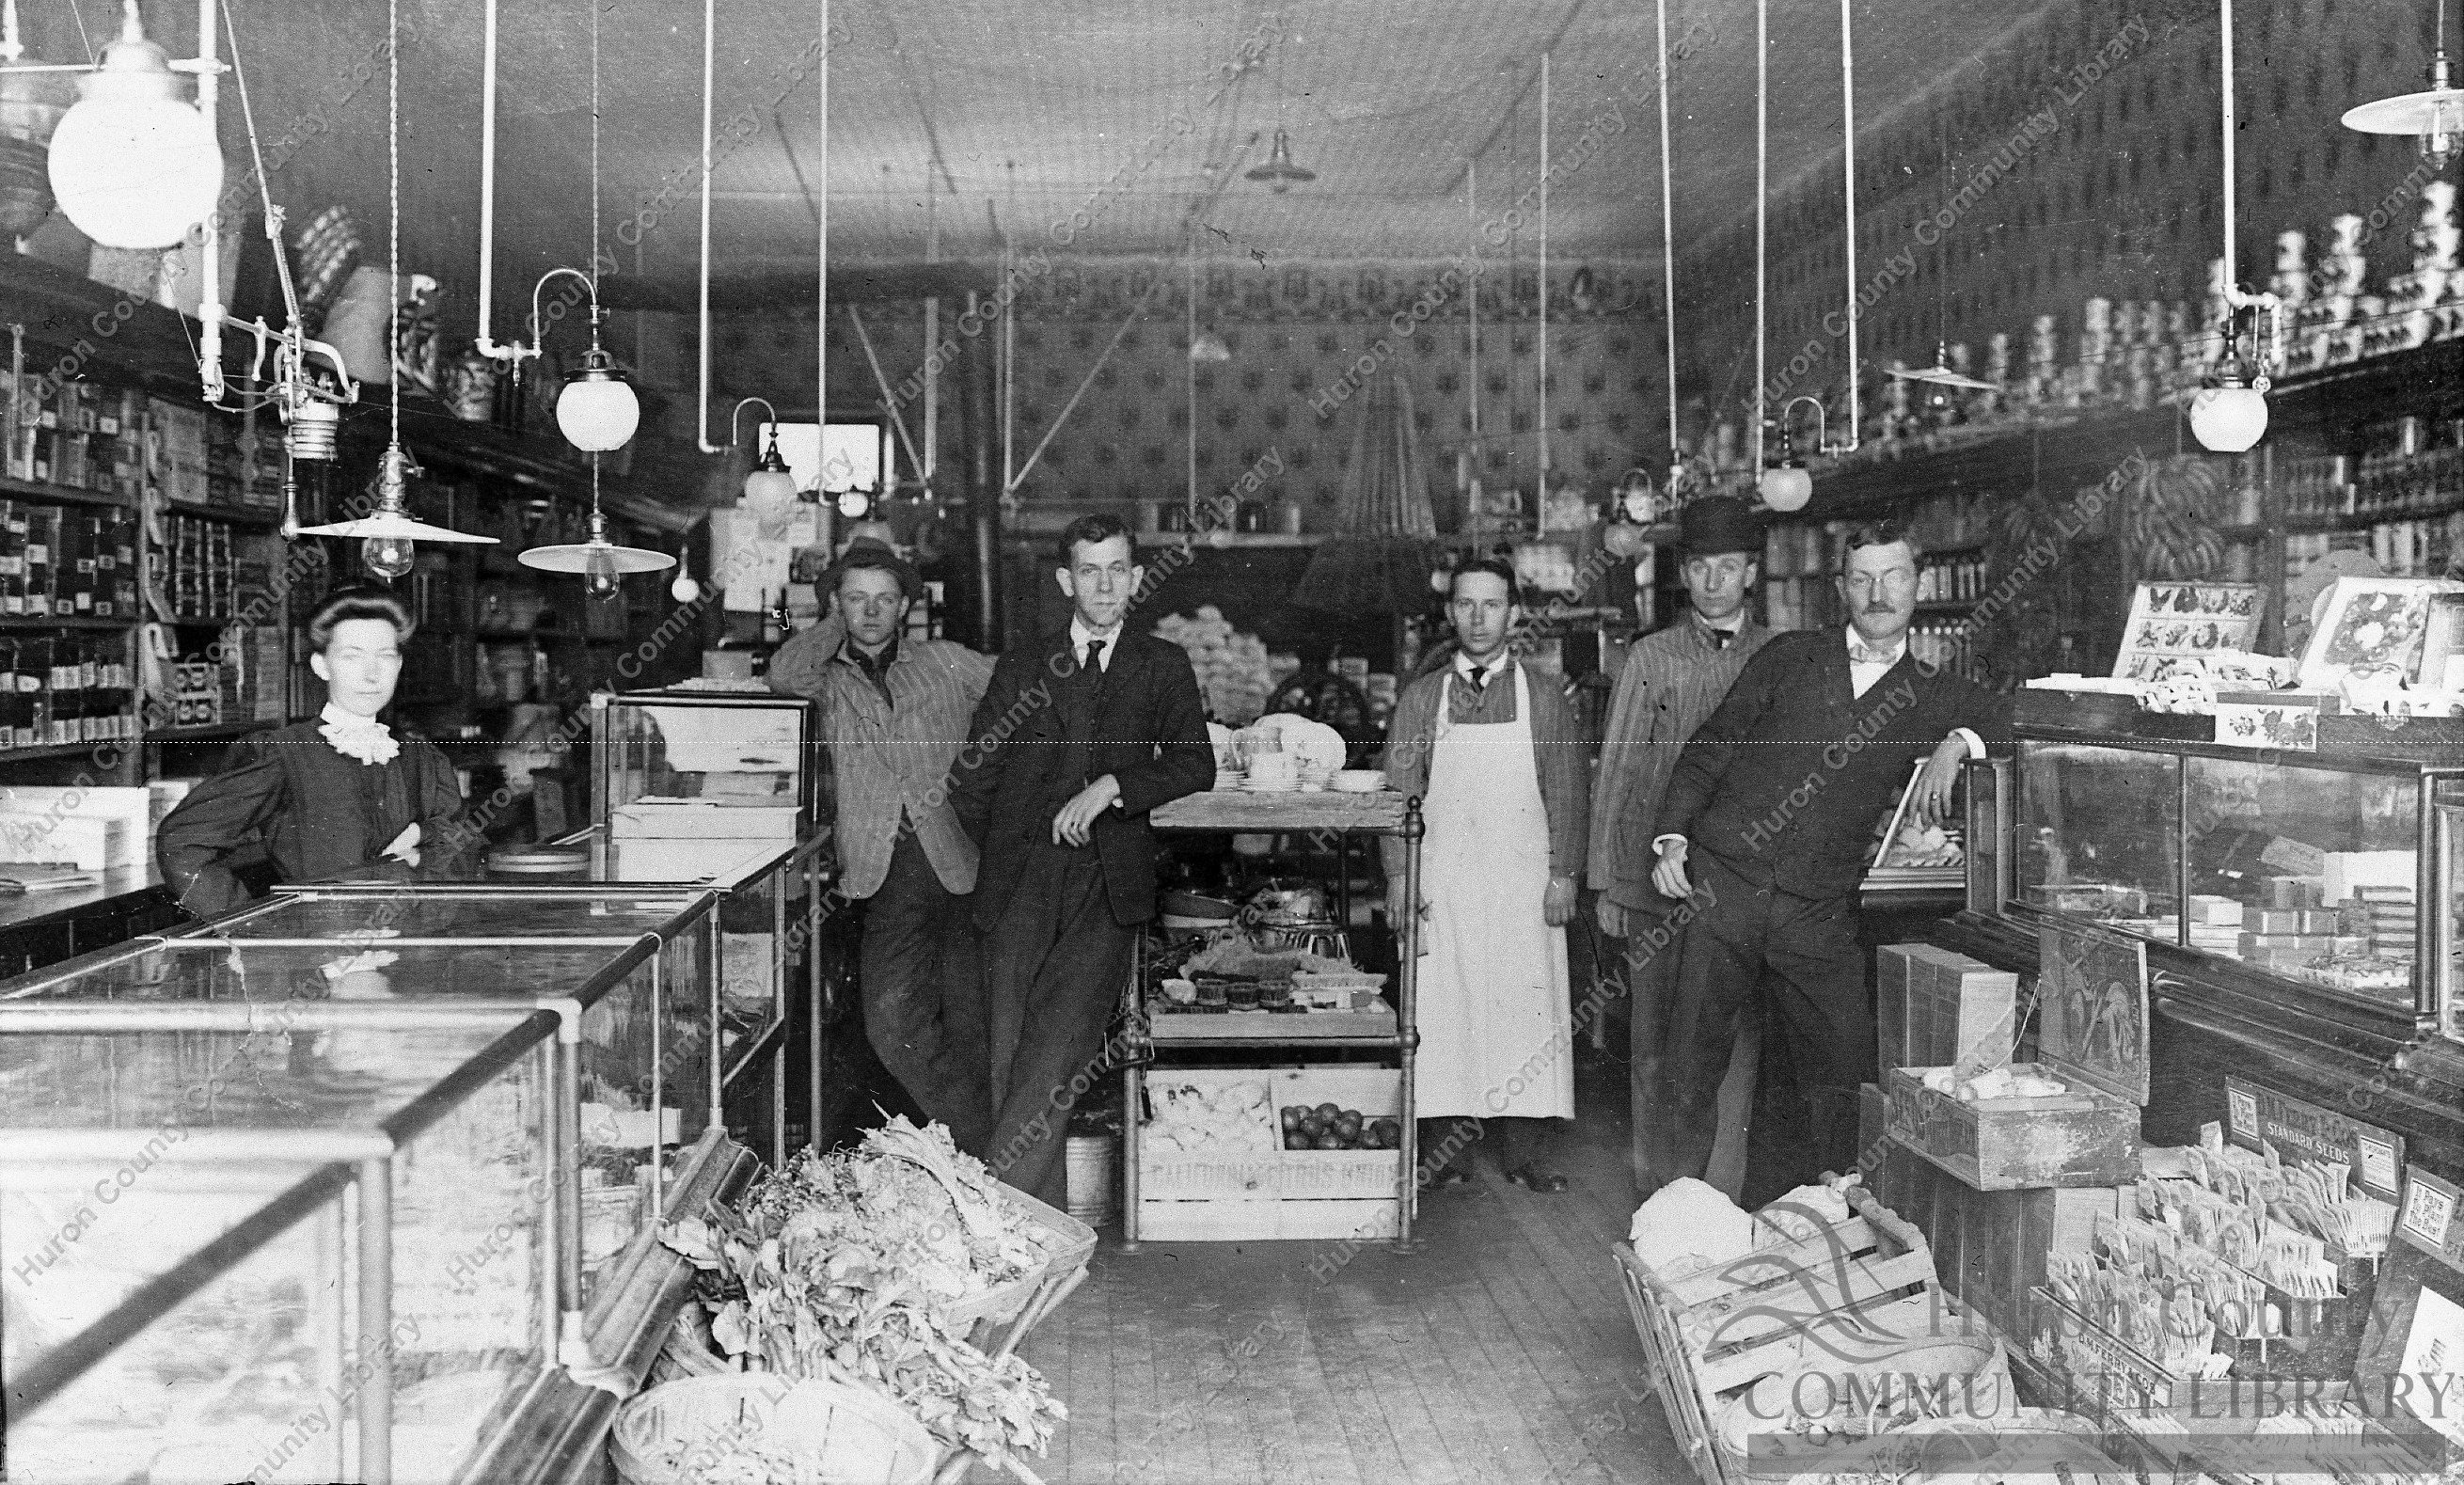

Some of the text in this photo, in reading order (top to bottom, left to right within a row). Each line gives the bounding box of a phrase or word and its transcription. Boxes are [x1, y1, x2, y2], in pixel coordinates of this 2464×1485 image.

[2267, 1122, 2313, 1151] STANDARD
[2315, 1141, 2350, 1165] SEEDS
[2424, 1189, 2443, 1211] Pays
